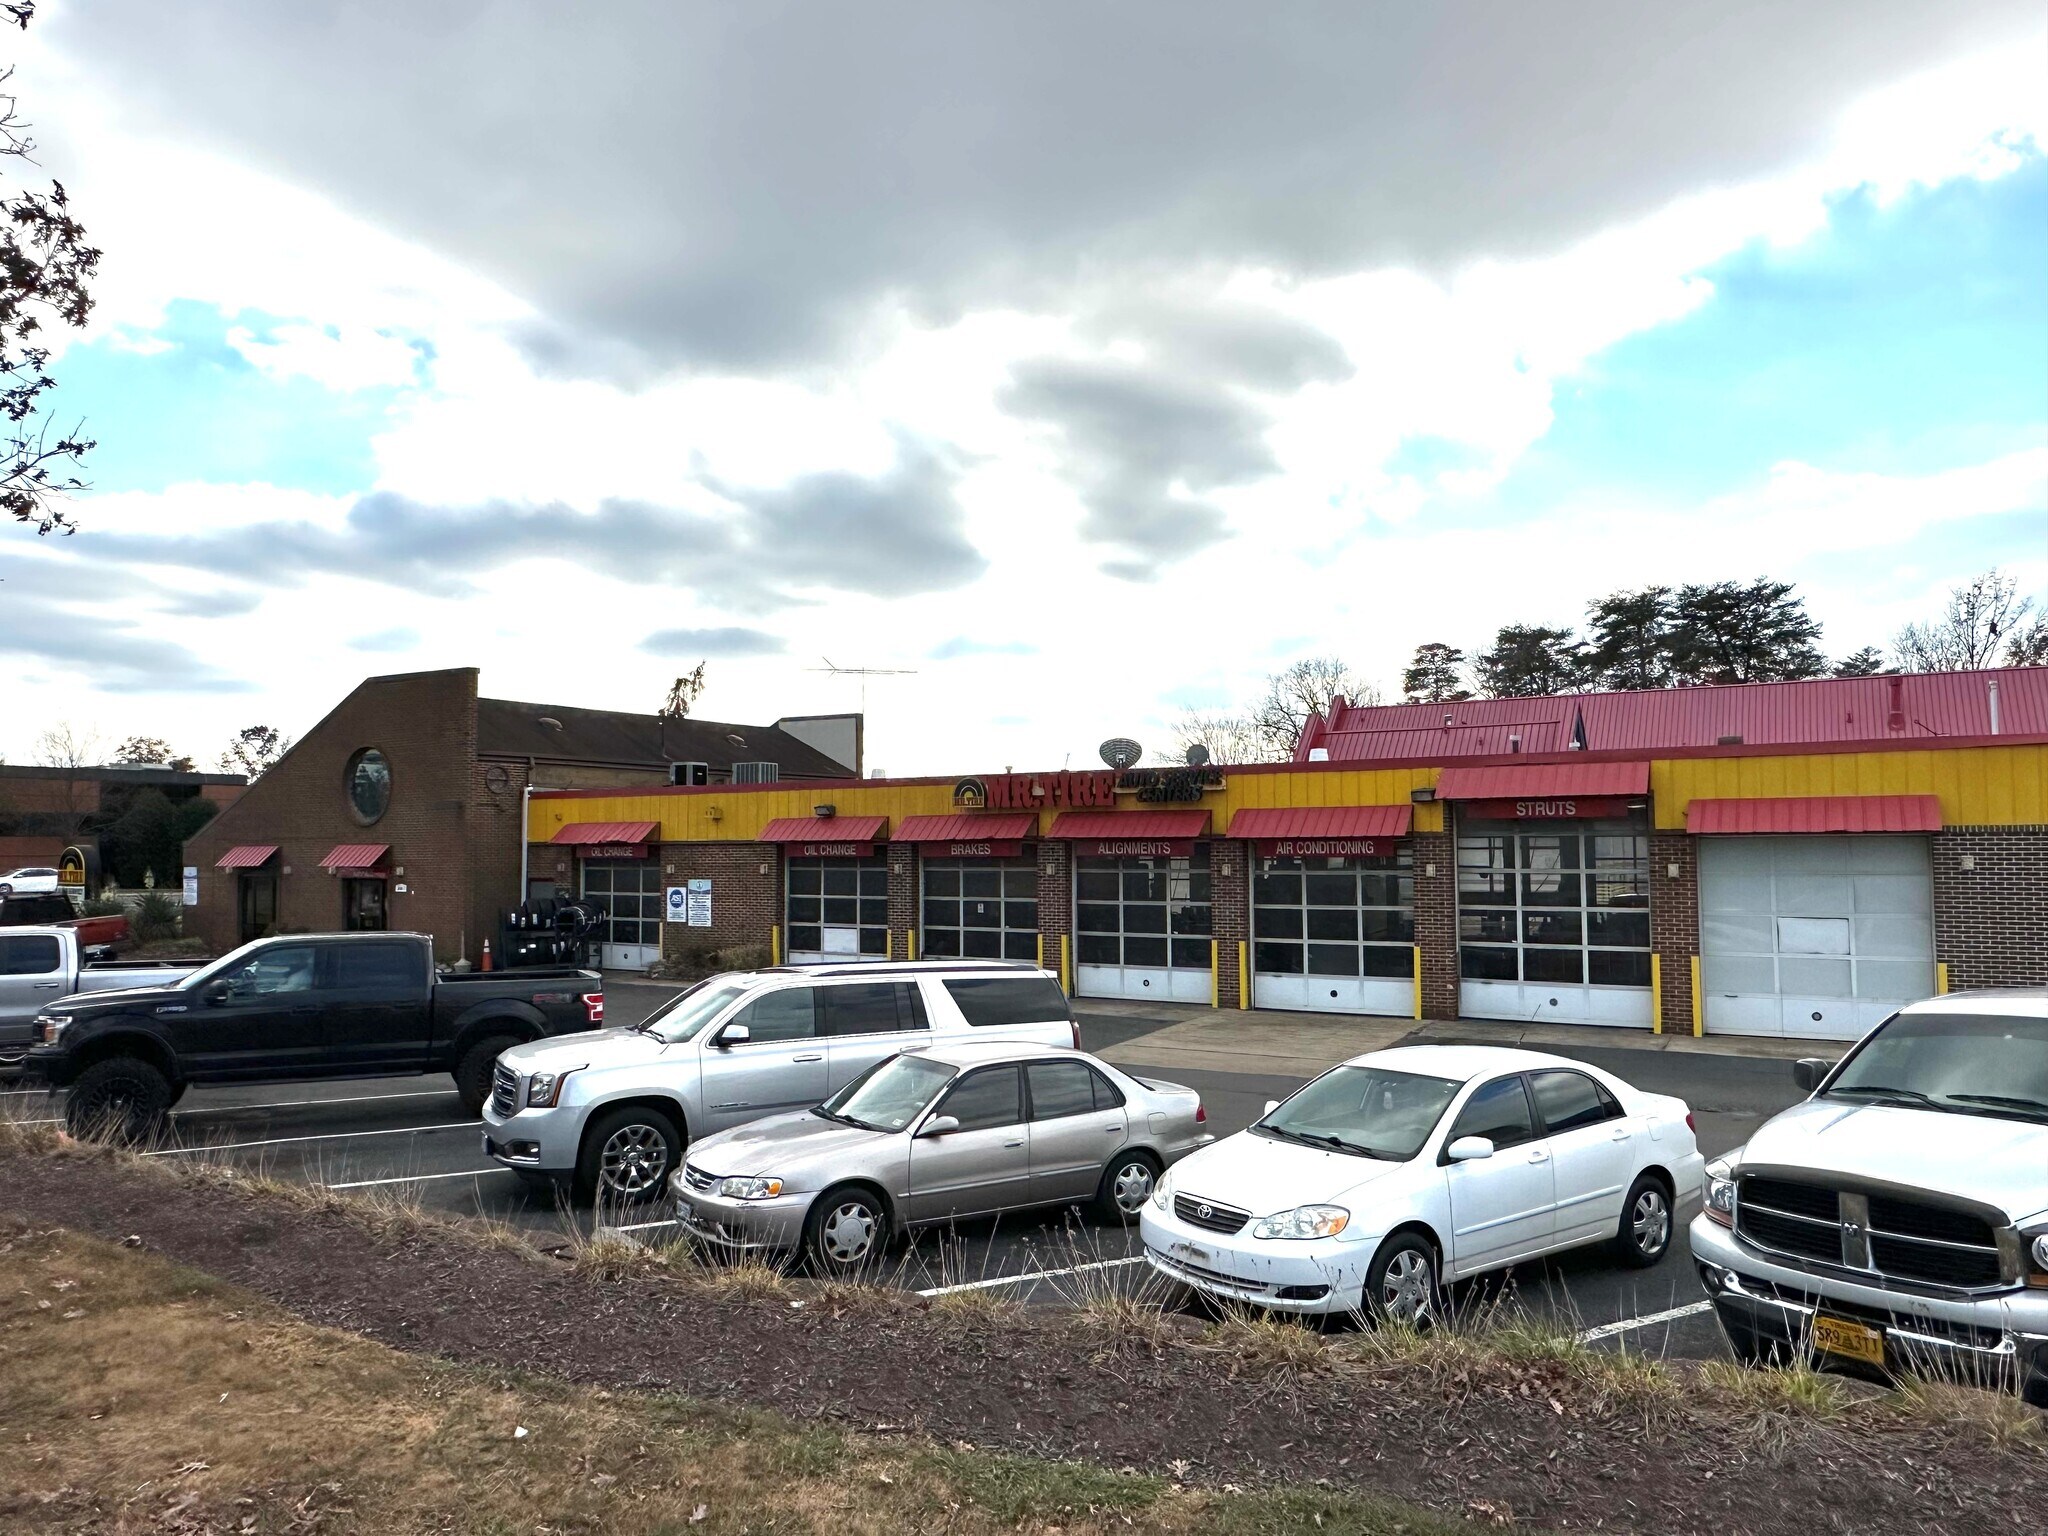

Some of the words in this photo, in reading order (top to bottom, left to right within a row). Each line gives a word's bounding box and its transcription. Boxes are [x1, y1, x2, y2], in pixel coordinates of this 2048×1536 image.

[1038, 772, 1116, 807] TIRE
[1516, 801, 1576, 816] STRUTS
[604, 847, 633, 856] CHANGE
[804, 845, 818, 855] OIL
[820, 845, 857, 855] CHANGE
[951, 843, 991, 855] BRAKES
[1098, 842, 1171, 854] ALIGNMENTS
[1276, 842, 1293, 854] AIR
[1296, 841, 1374, 854] CONDITIONING
